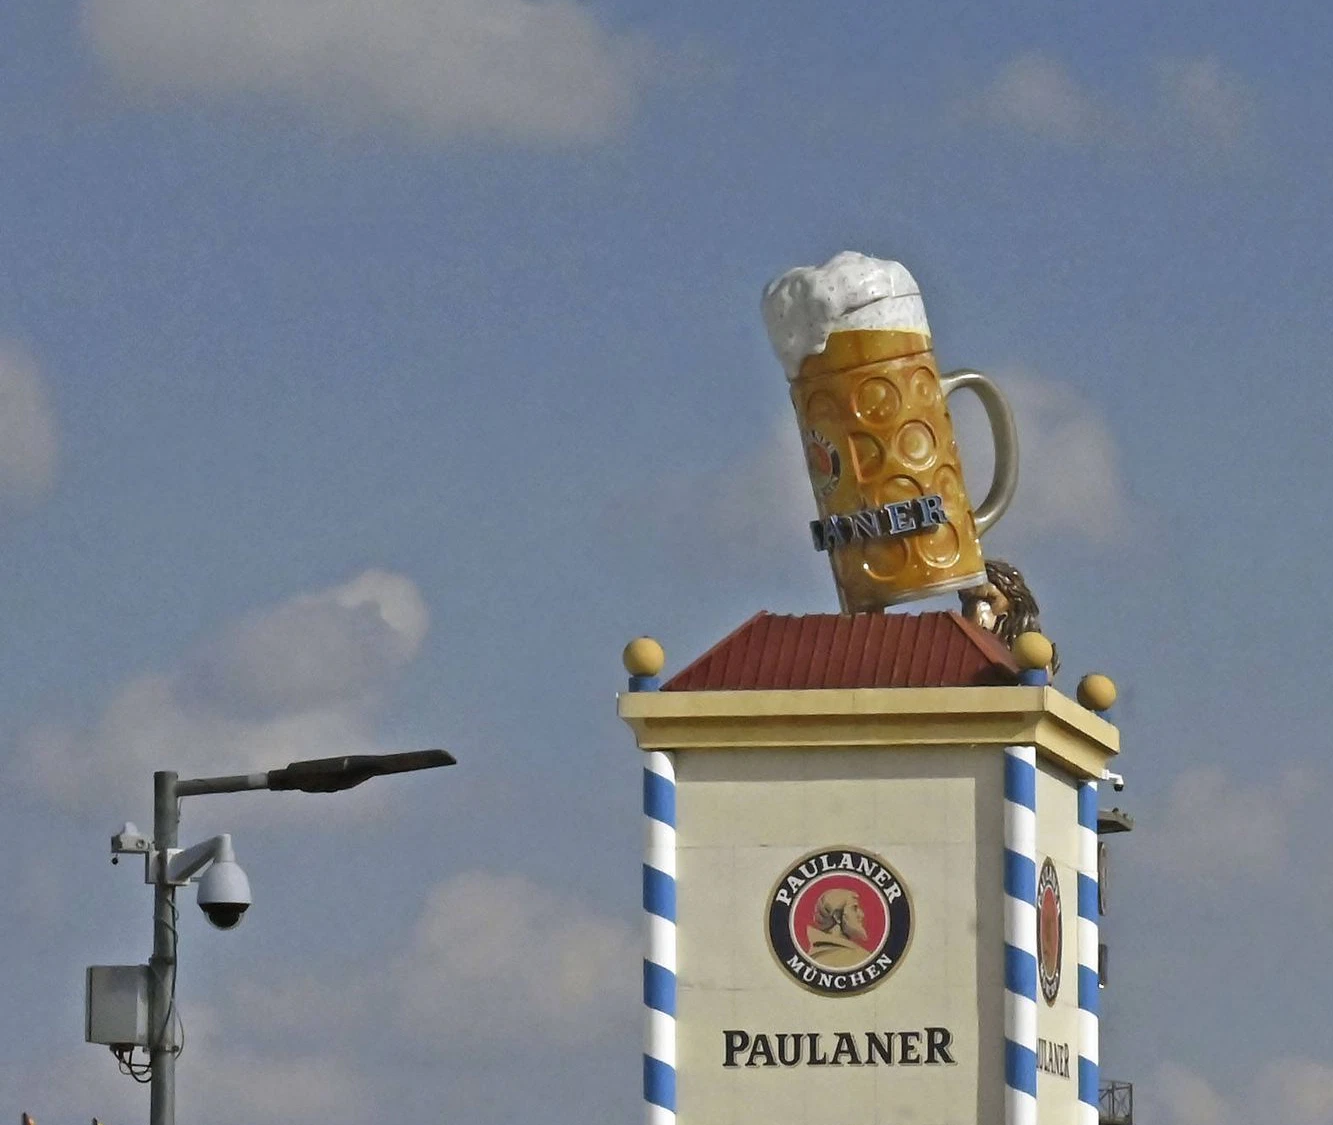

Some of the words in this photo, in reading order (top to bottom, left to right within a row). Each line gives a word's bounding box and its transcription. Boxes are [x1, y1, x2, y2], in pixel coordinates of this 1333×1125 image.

[810, 494, 947, 552] ANER
[776, 853, 902, 906] PAULANER
[786, 954, 893, 989] MÜNCHEN
[722, 1027, 958, 1068] PAULANER
